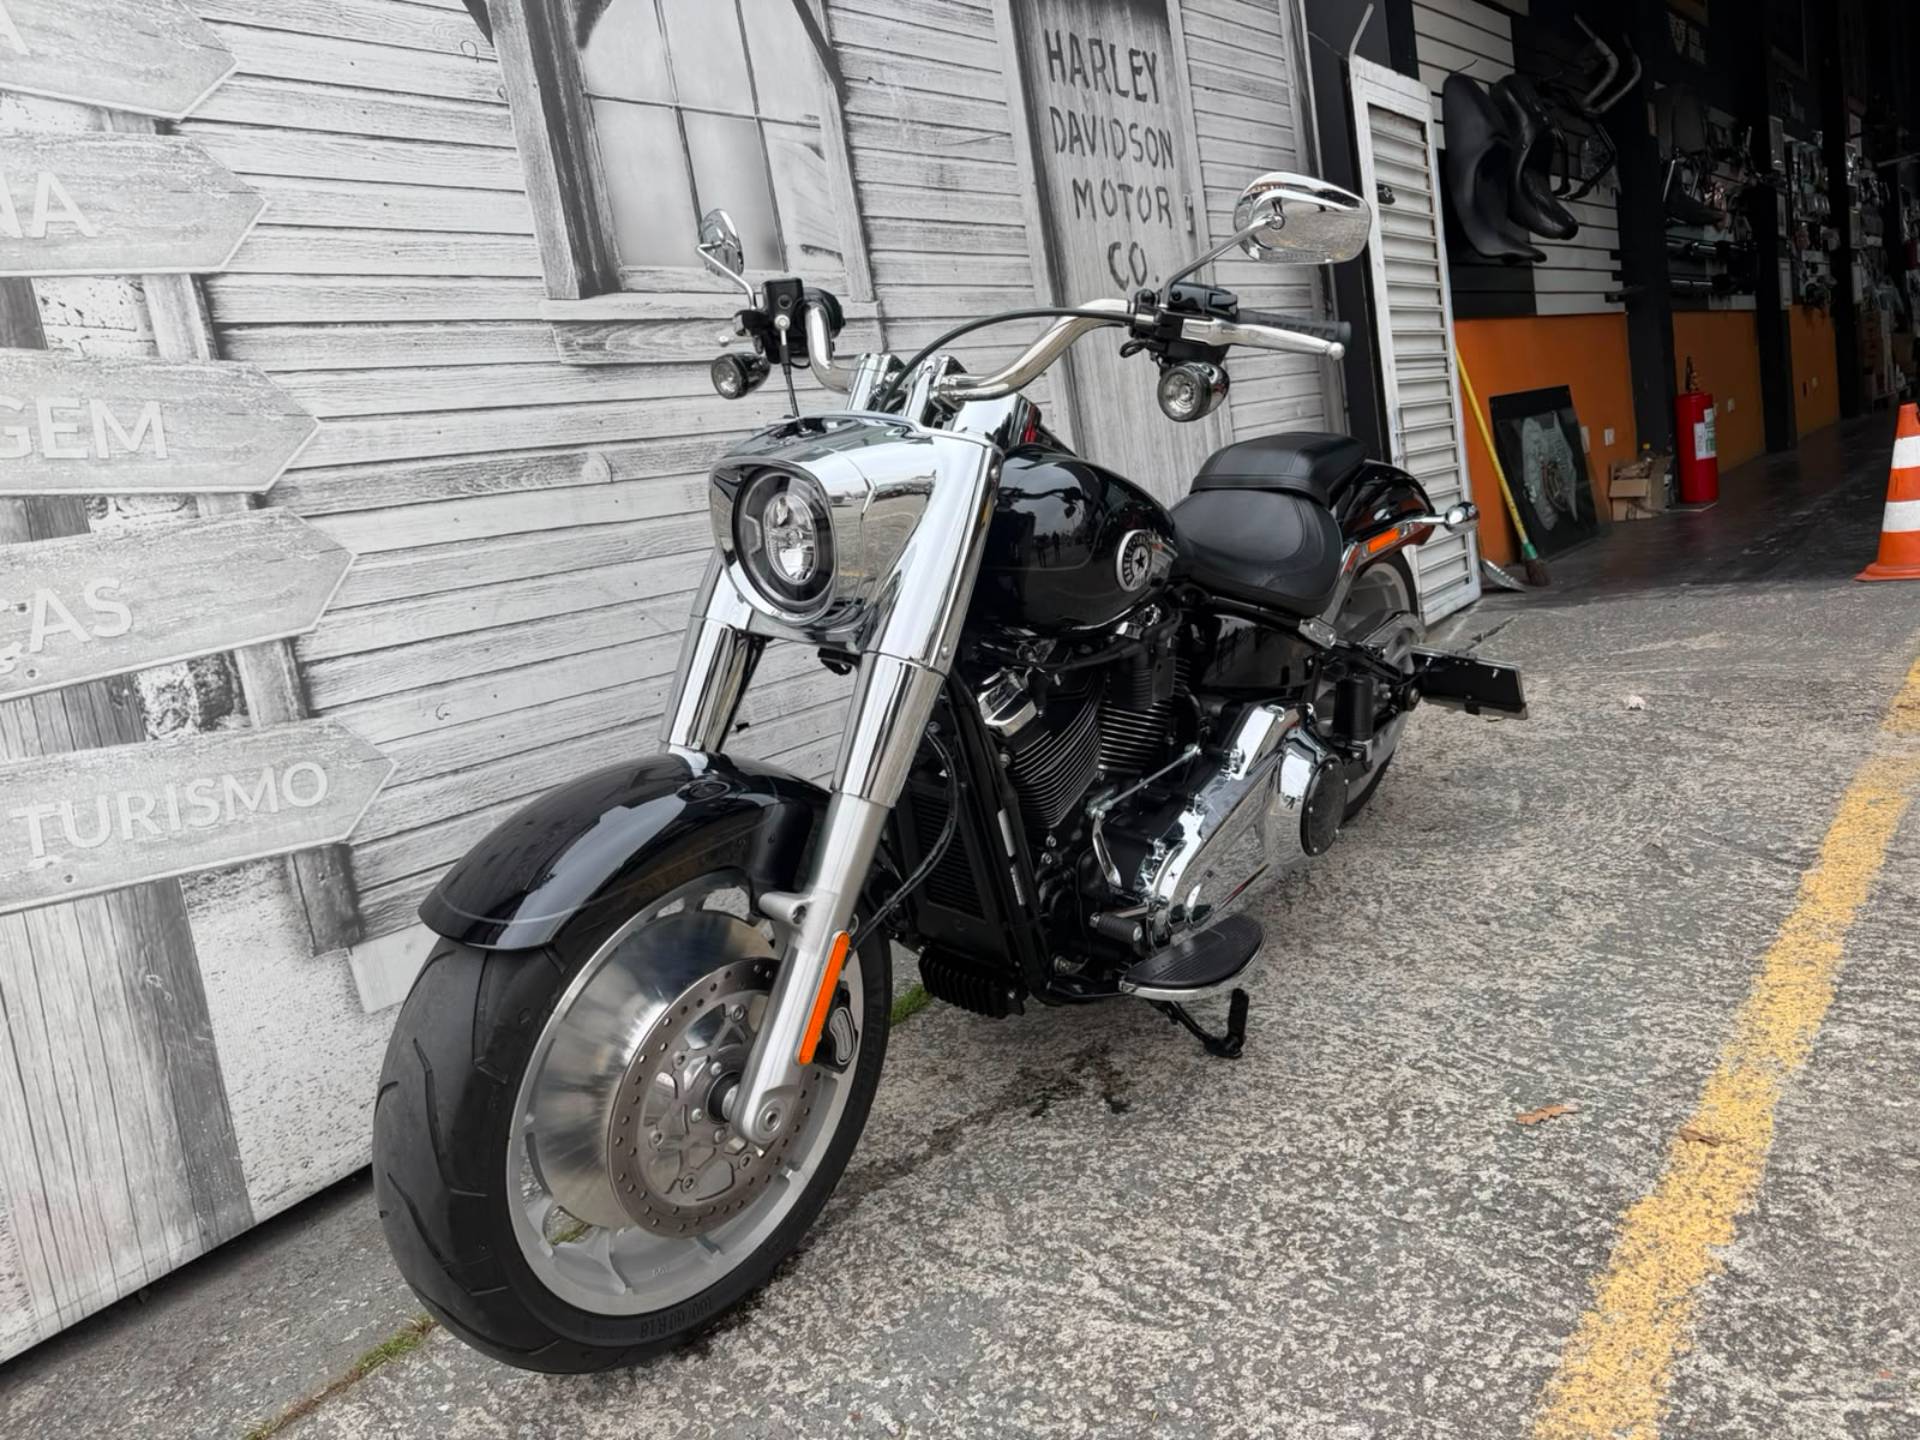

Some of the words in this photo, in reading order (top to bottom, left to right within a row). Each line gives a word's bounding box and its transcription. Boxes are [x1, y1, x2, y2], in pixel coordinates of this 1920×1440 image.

[1044, 29, 1160, 105] HARLEY
[1049, 106, 1175, 170] DAVIDSON
[1072, 178, 1173, 230] MOTOR
[1107, 241, 1160, 291] CO.
[9, 761, 329, 858] TURISMO
